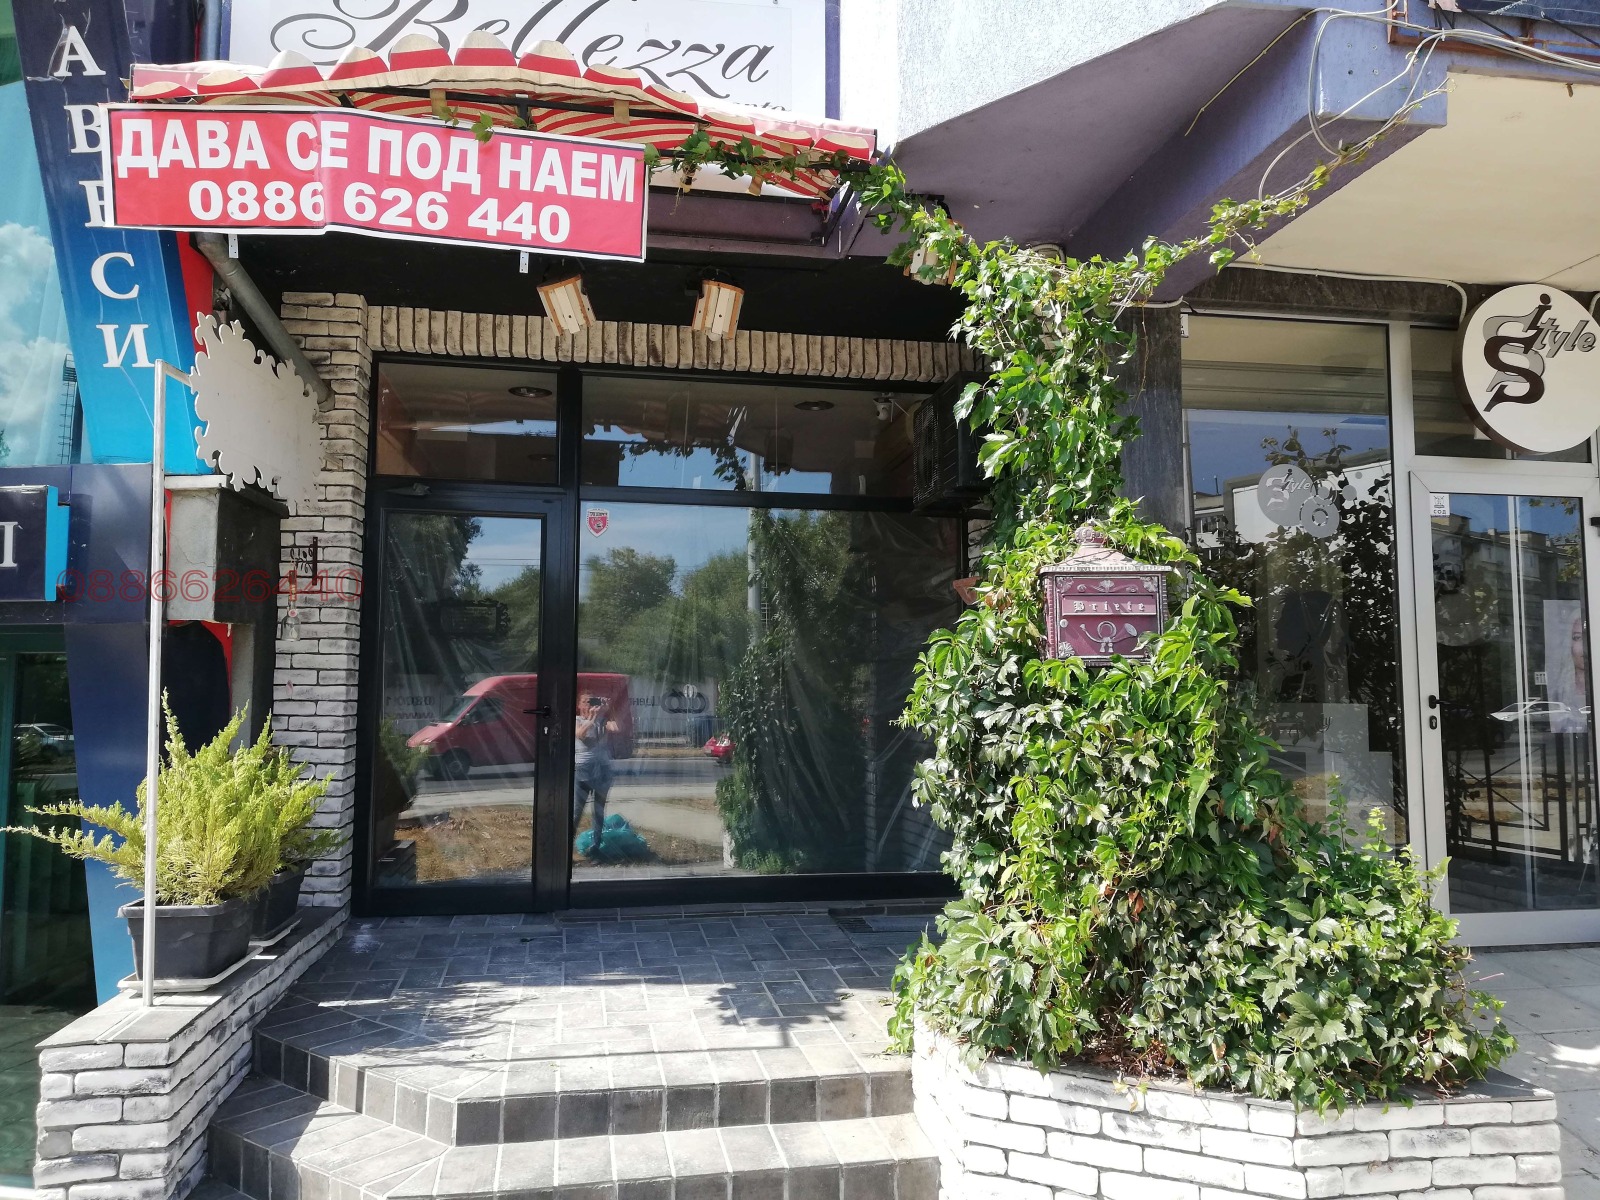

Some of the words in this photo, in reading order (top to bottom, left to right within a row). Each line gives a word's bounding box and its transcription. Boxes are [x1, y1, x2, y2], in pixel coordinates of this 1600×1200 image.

[117, 118, 271, 178] ДАВА
[286, 121, 349, 170] СЕ
[367, 128, 481, 195] ПОД
[498, 149, 635, 203] НАЕМ
[188, 180, 325, 221] 0886
[343, 182, 449, 230] 626
[467, 202, 570, 243] 440
